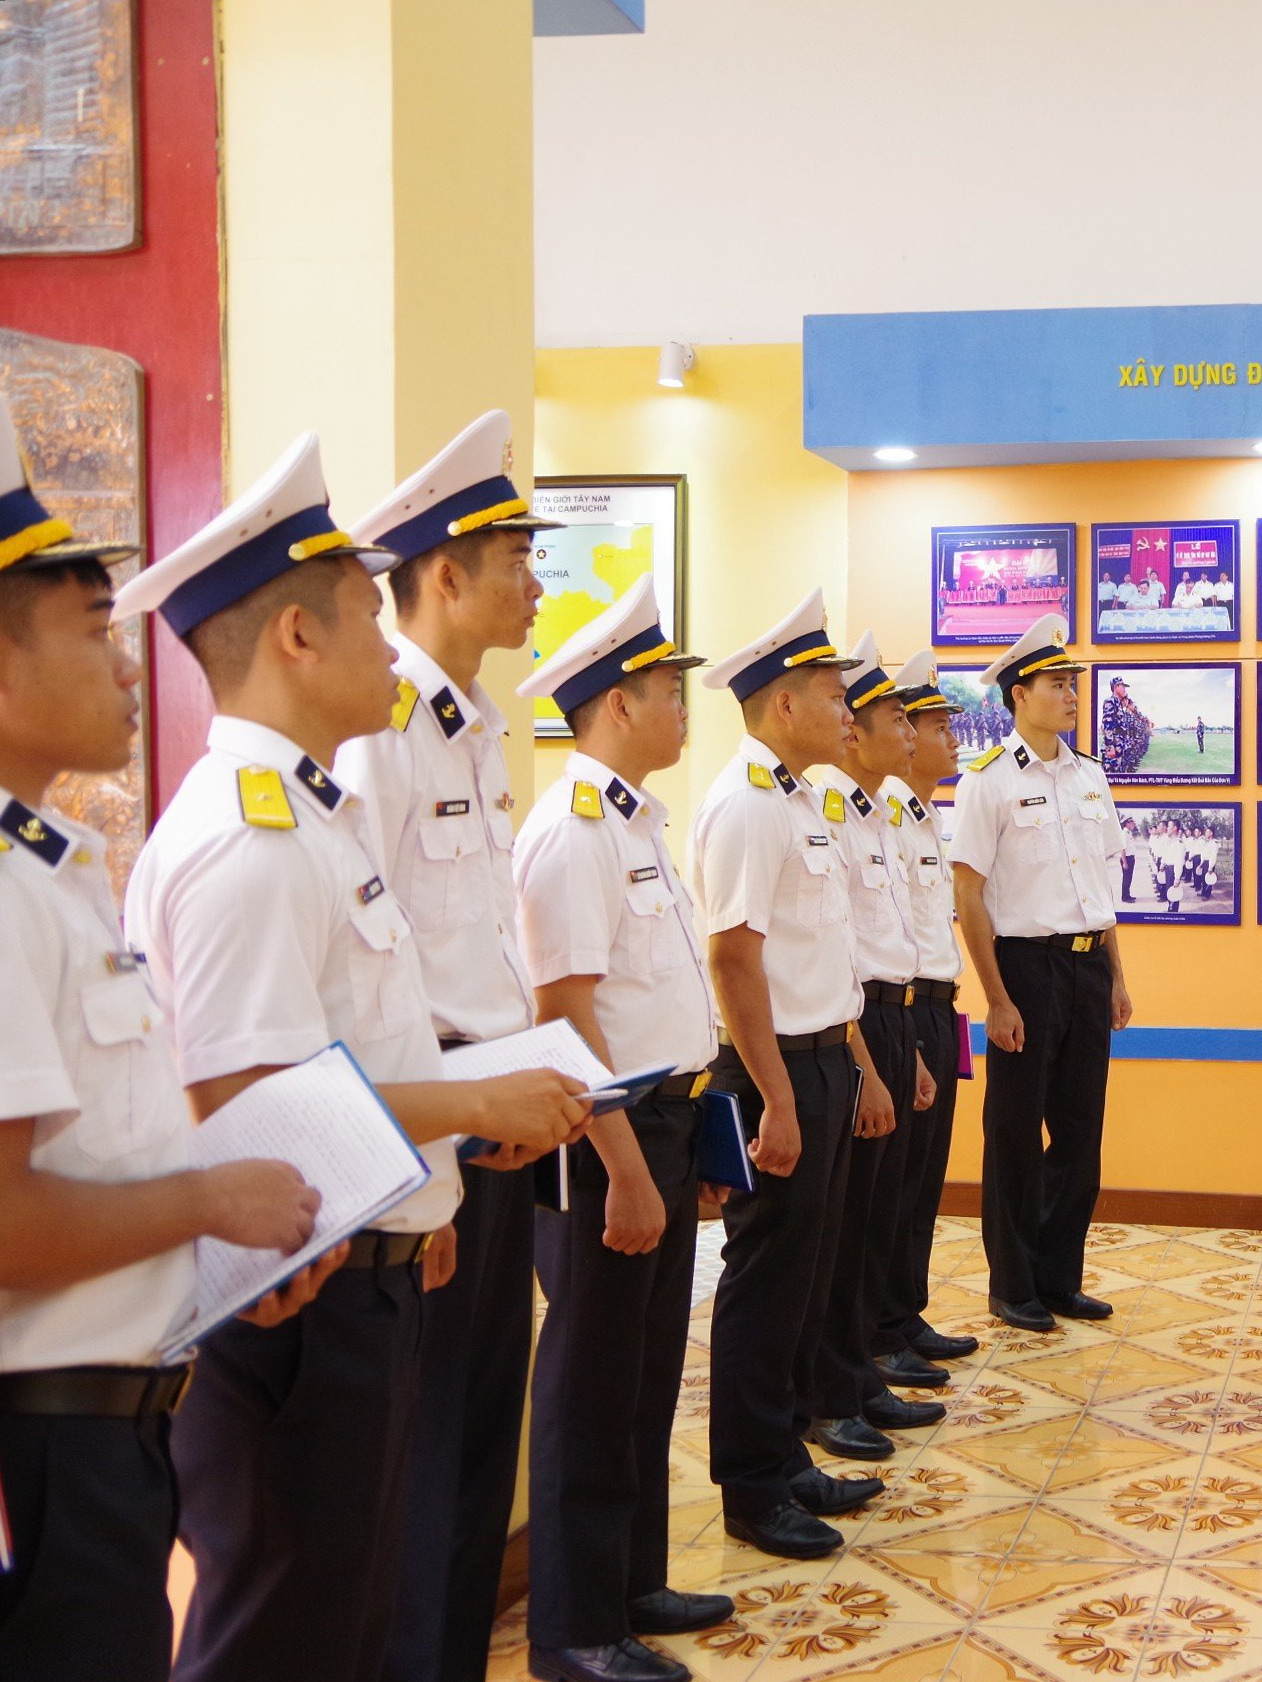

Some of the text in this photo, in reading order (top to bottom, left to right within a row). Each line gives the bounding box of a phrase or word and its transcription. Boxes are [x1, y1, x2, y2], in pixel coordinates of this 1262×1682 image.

[1118, 358, 1165, 387] XÂY
[1174, 360, 1237, 390] DỰNG
[558, 504, 608, 513] CAMPUCHIA
